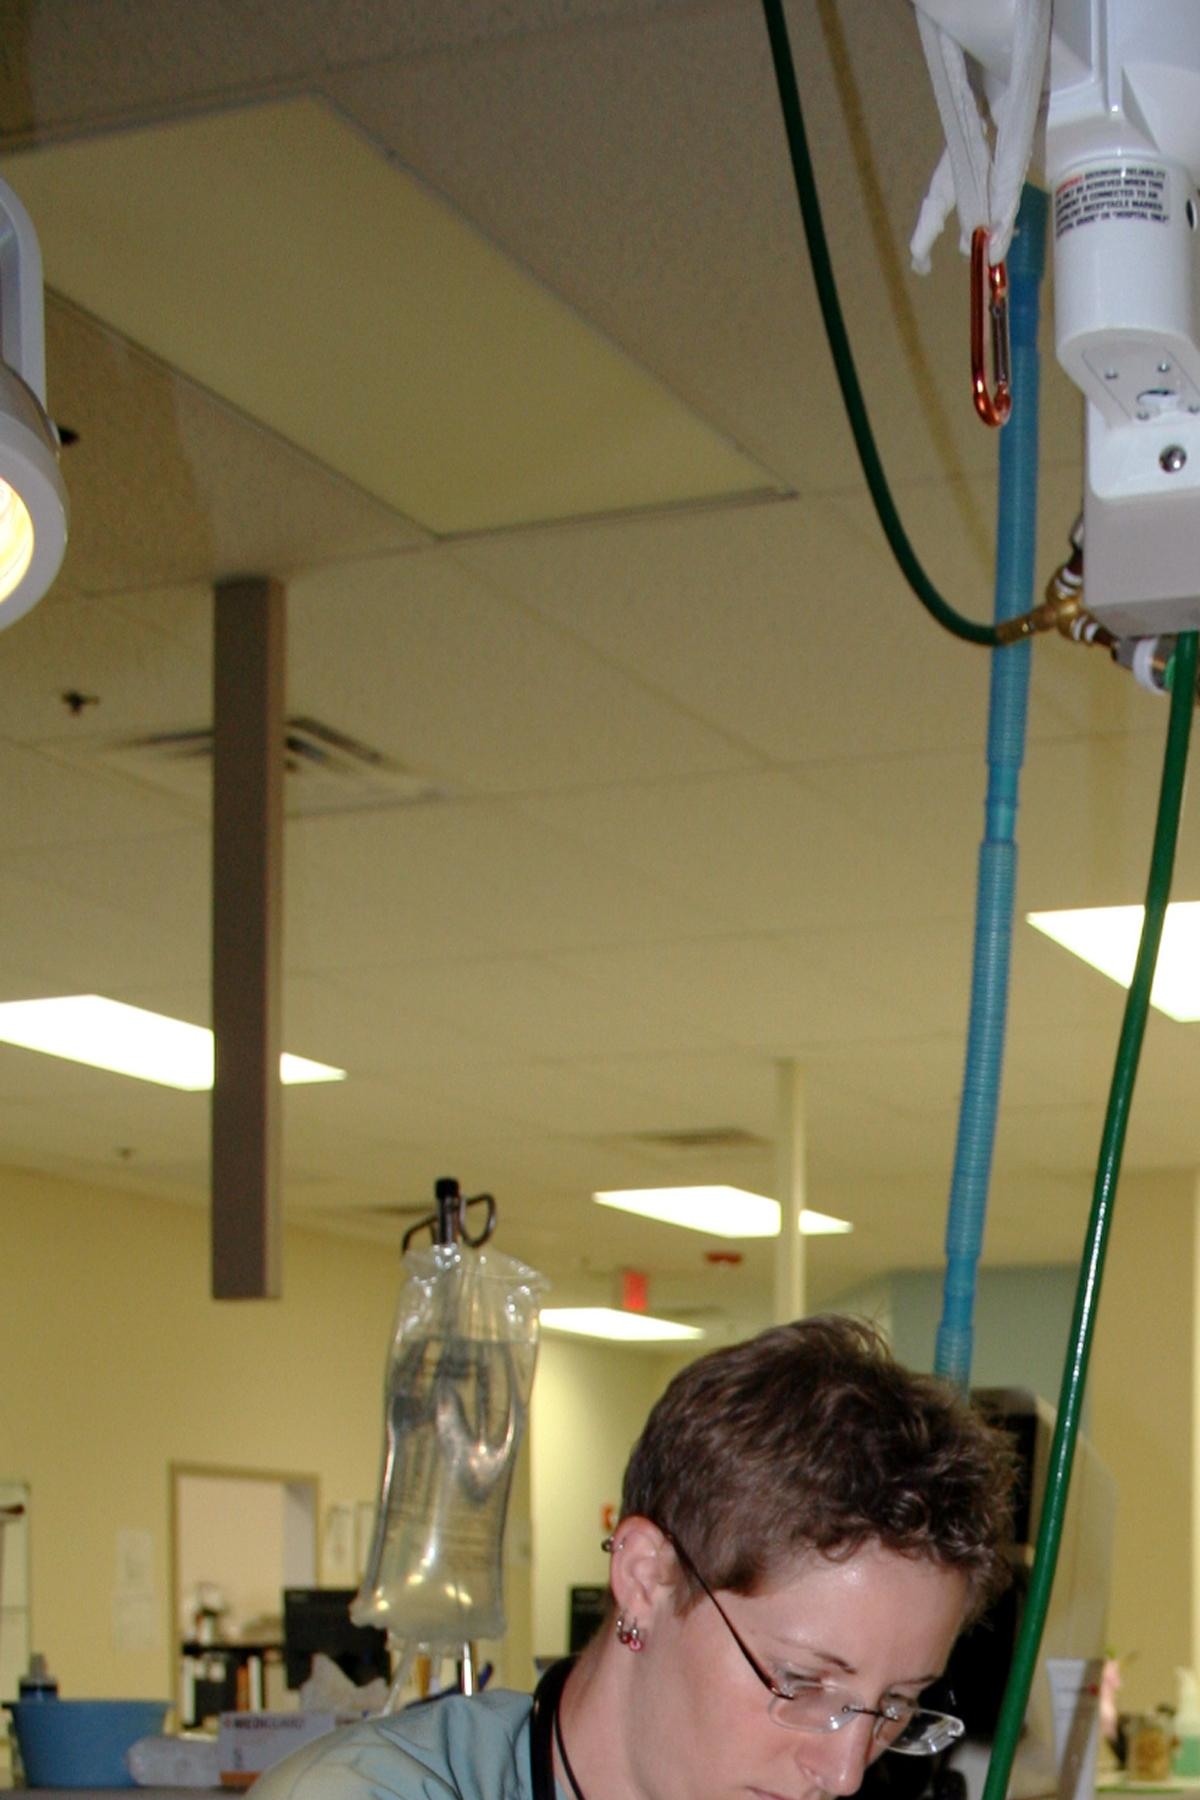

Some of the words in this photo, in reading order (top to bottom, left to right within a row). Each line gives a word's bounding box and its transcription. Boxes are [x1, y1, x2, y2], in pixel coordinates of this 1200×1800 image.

[1086, 179, 1121, 191] ACHIEVED
[1124, 179, 1146, 187] WHEN
[1148, 180, 1164, 191] THIS
[1090, 189, 1134, 200] CONNECTED
[1137, 189, 1146, 197] TO
[1148, 190, 1159, 198] AN
[1084, 199, 1129, 212] RECEPTACLE
